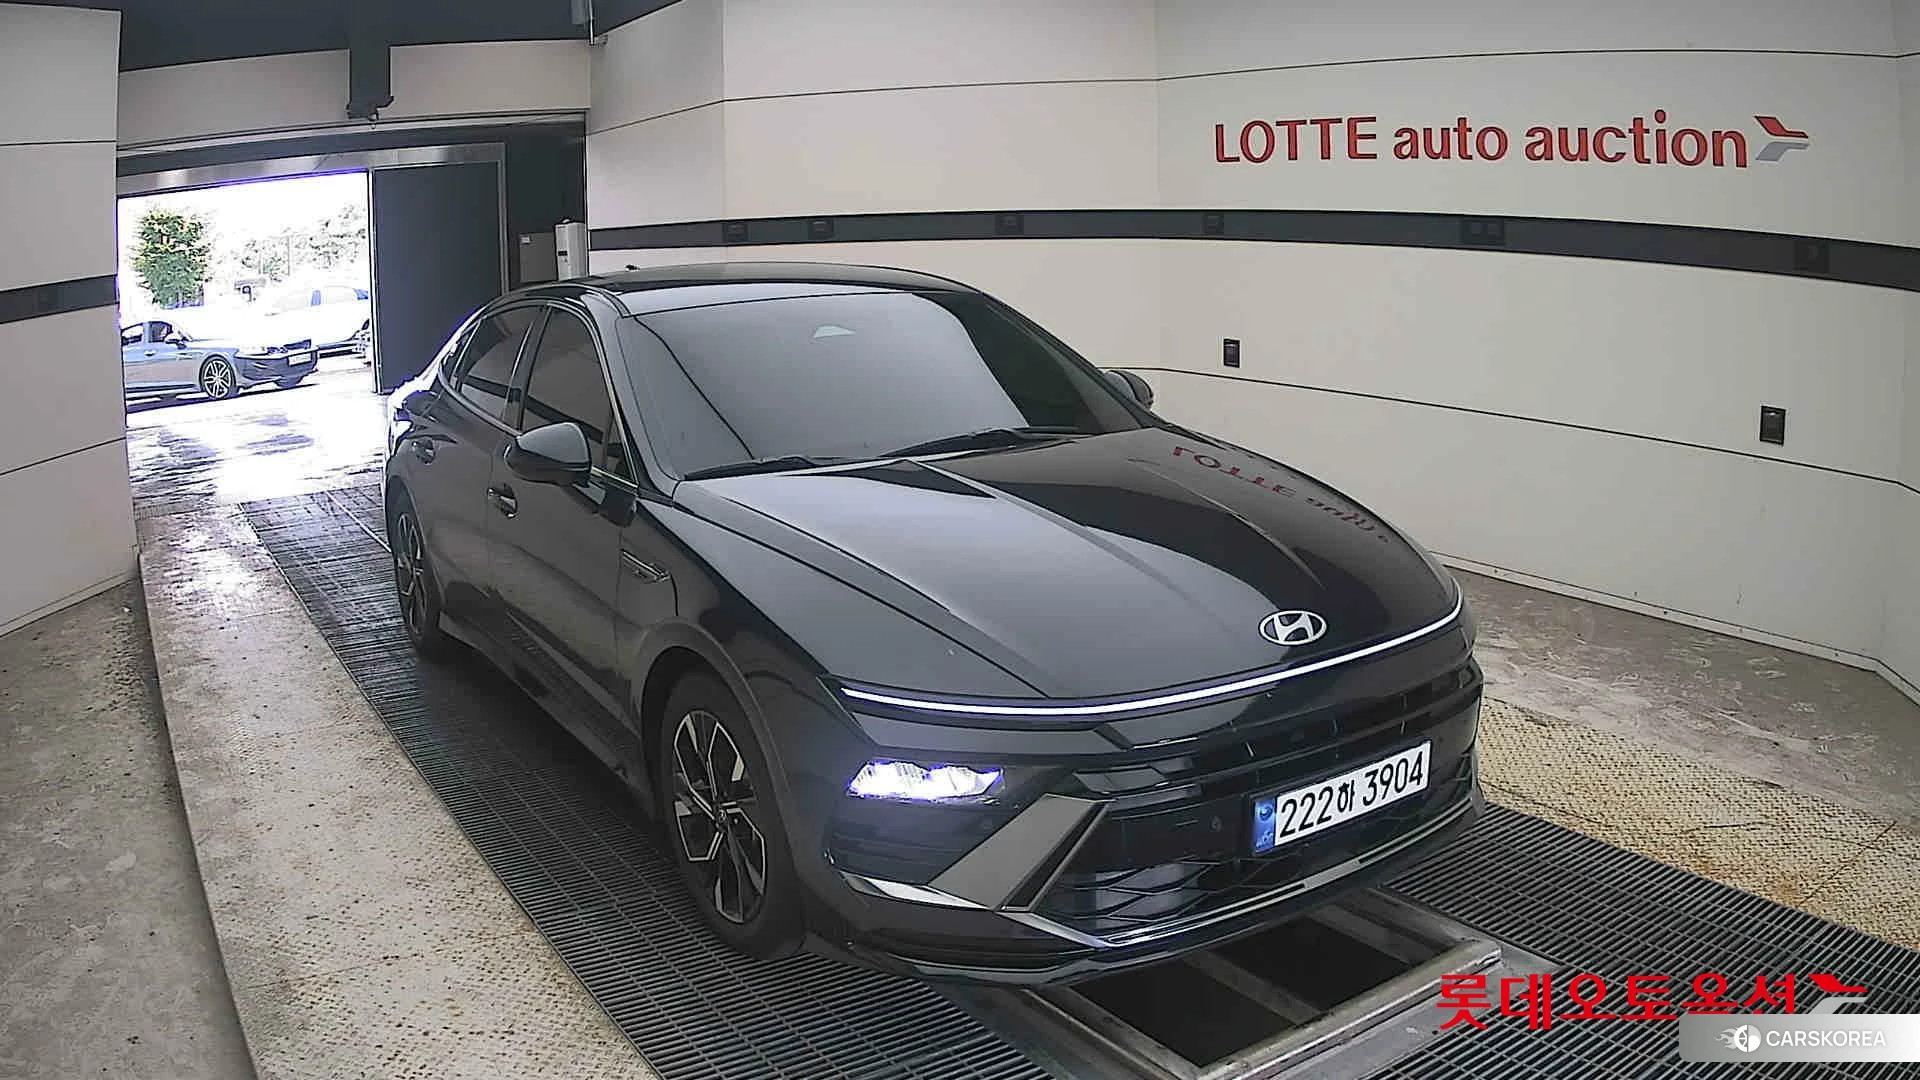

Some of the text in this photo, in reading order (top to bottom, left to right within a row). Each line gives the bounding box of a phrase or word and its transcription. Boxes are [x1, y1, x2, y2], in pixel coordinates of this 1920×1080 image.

[1215, 109, 1748, 168] LOTTE auto auction
[1362, 750, 1424, 807] 3904
